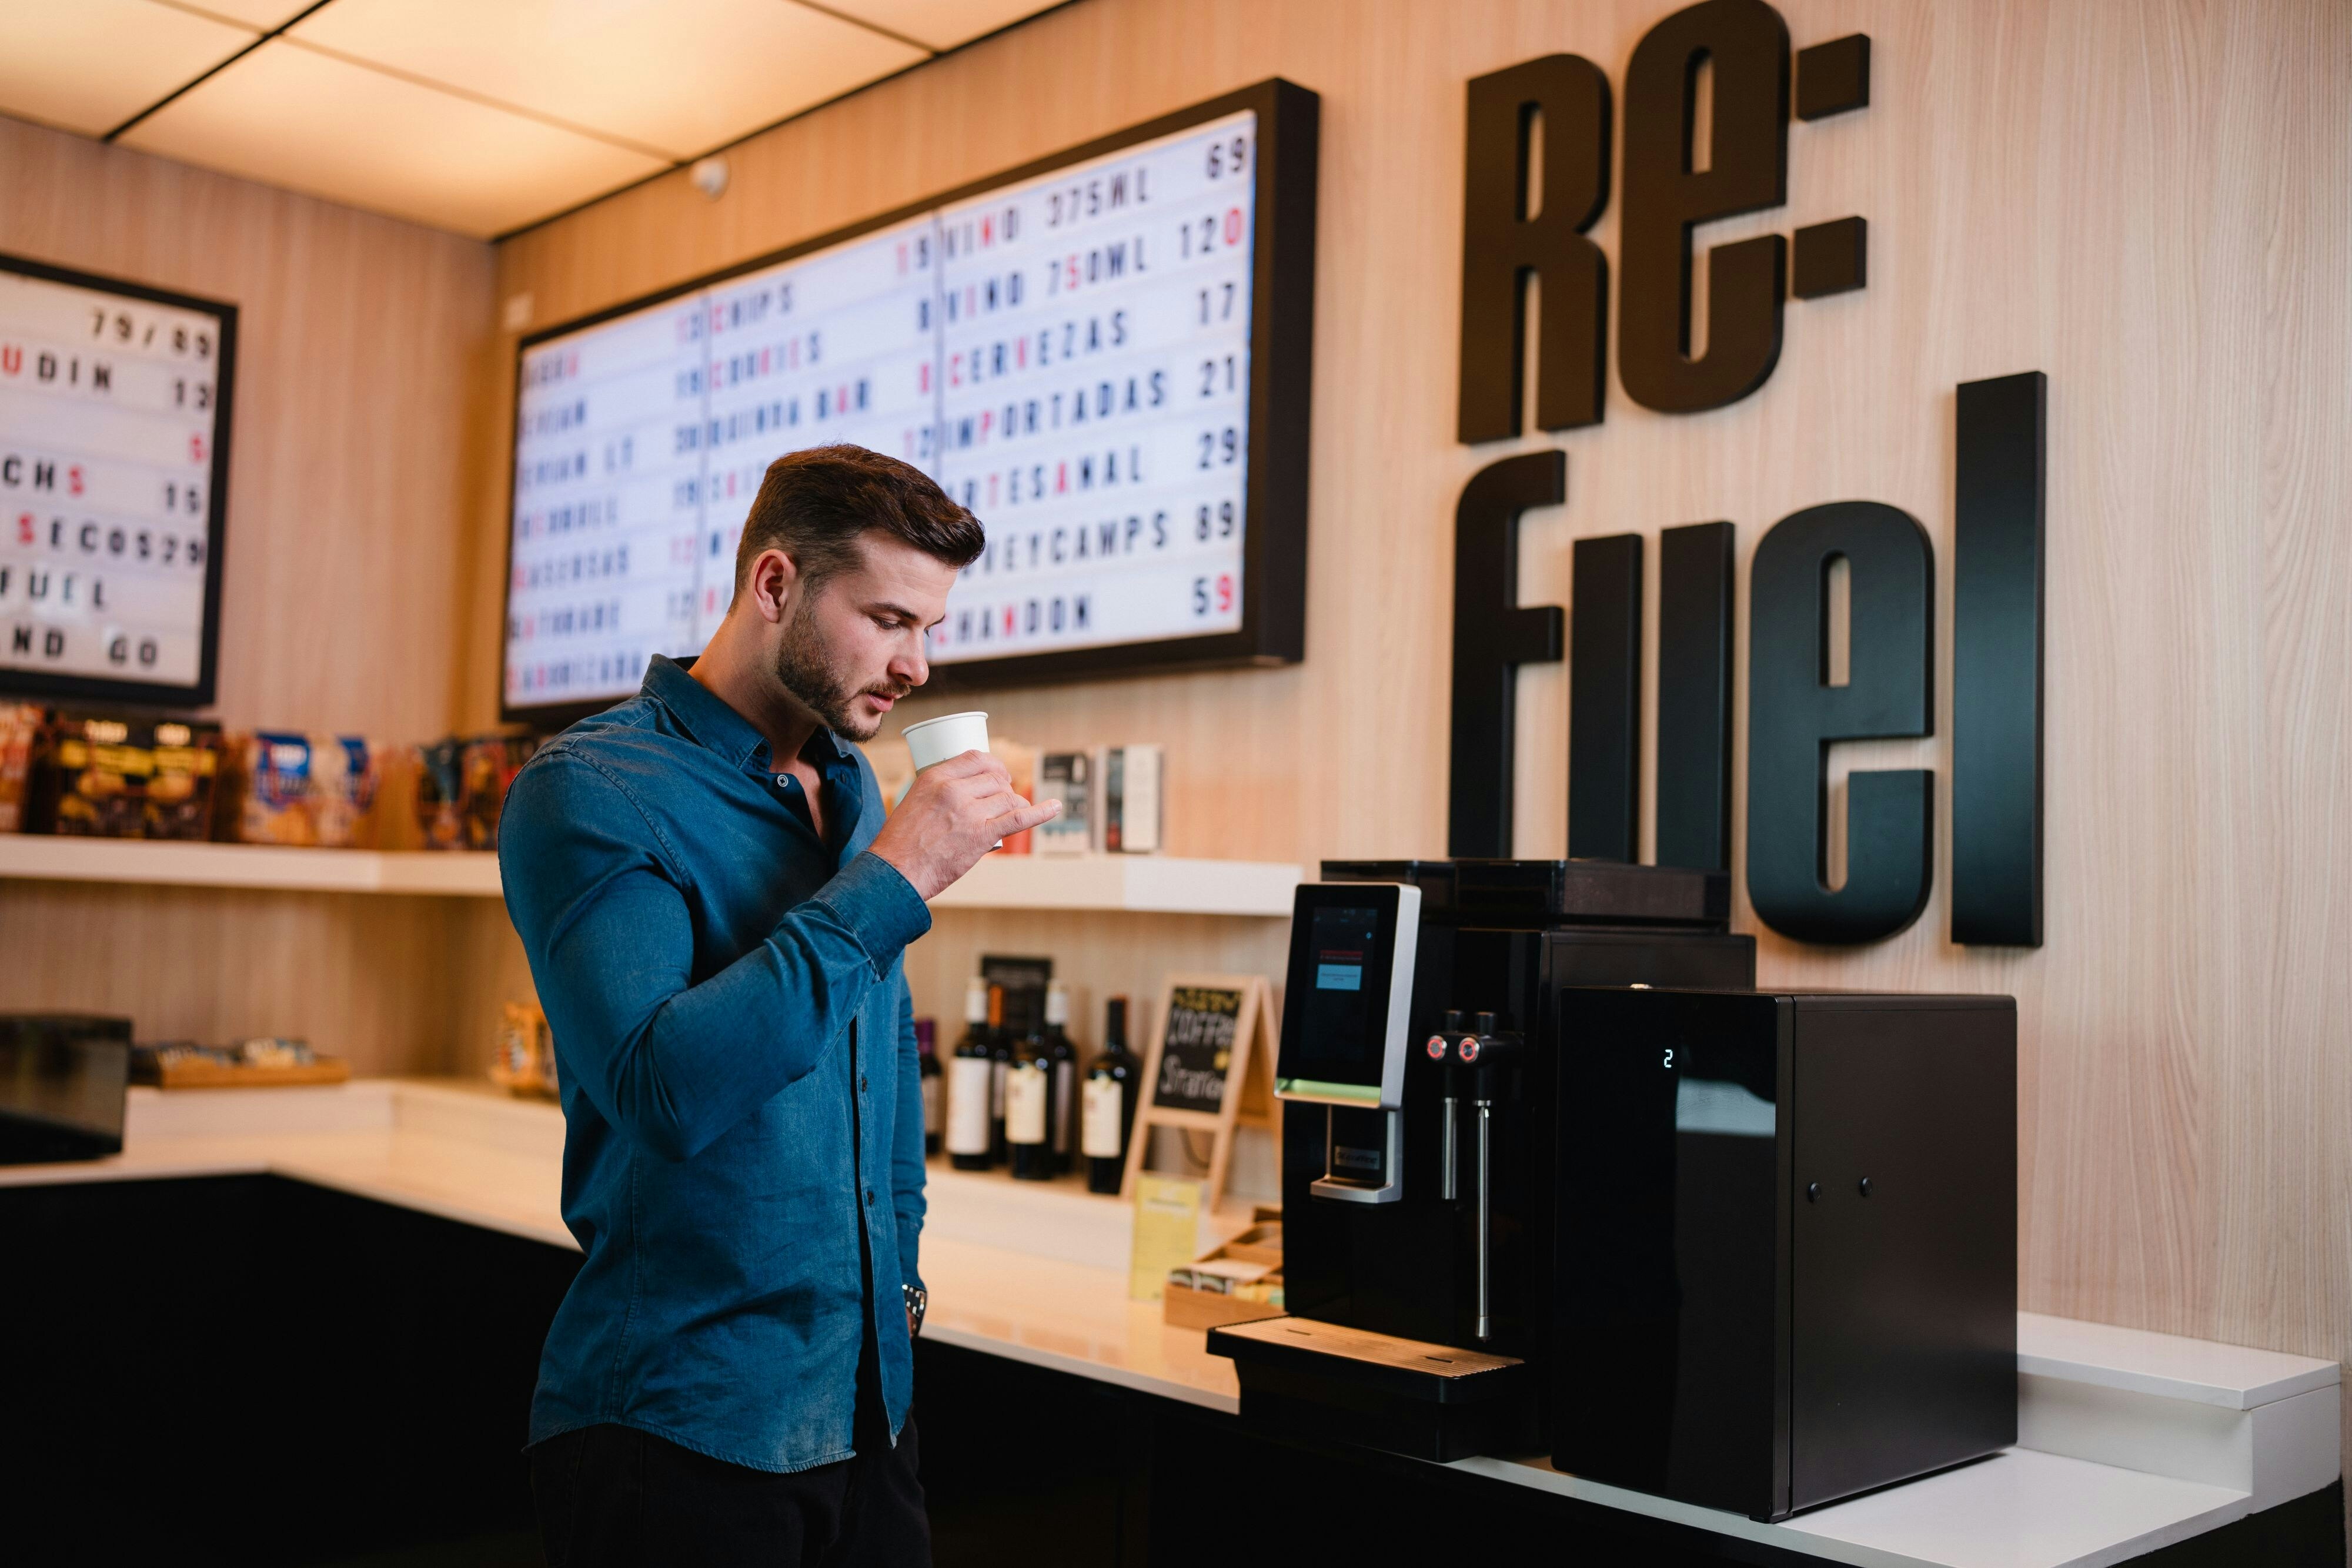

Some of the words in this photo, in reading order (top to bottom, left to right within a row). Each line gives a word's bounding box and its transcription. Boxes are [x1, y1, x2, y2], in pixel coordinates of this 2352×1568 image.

[1206, 136, 1245, 181] 69
[1179, 208, 1243, 259] 120
[947, 310, 1128, 387] CERVEZAS
[1198, 281, 1235, 326] 17
[1200, 356, 1235, 397] 21
[1197, 427, 1238, 470] 29
[1196, 501, 1234, 542] 89
[1191, 574, 1234, 614] 59
[0, 626, 65, 657] ND
[1664, 1049, 1673, 1068] 2
